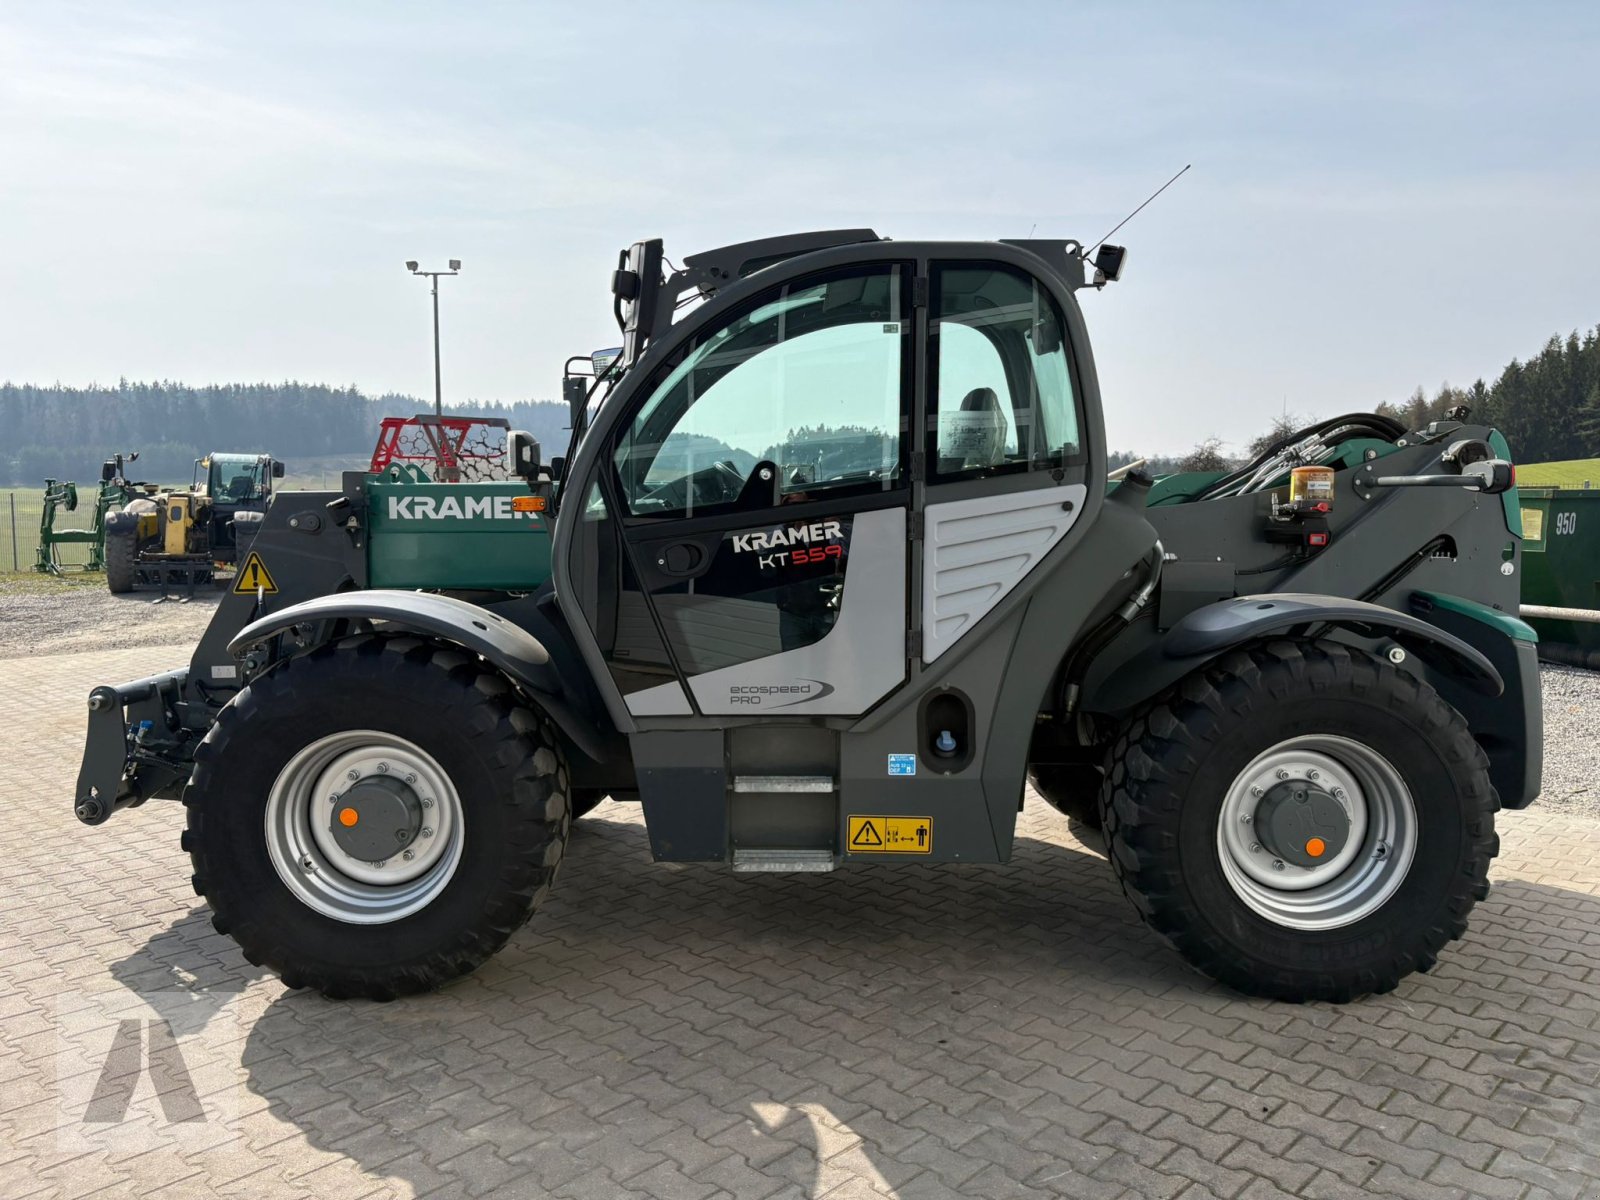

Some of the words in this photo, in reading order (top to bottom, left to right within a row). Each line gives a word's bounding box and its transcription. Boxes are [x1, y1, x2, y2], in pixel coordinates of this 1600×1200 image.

[1556, 512, 1577, 535] 950
[732, 521, 844, 554] KRAMER
[730, 684, 811, 696] ecospeed
[730, 695, 761, 705] PRO
